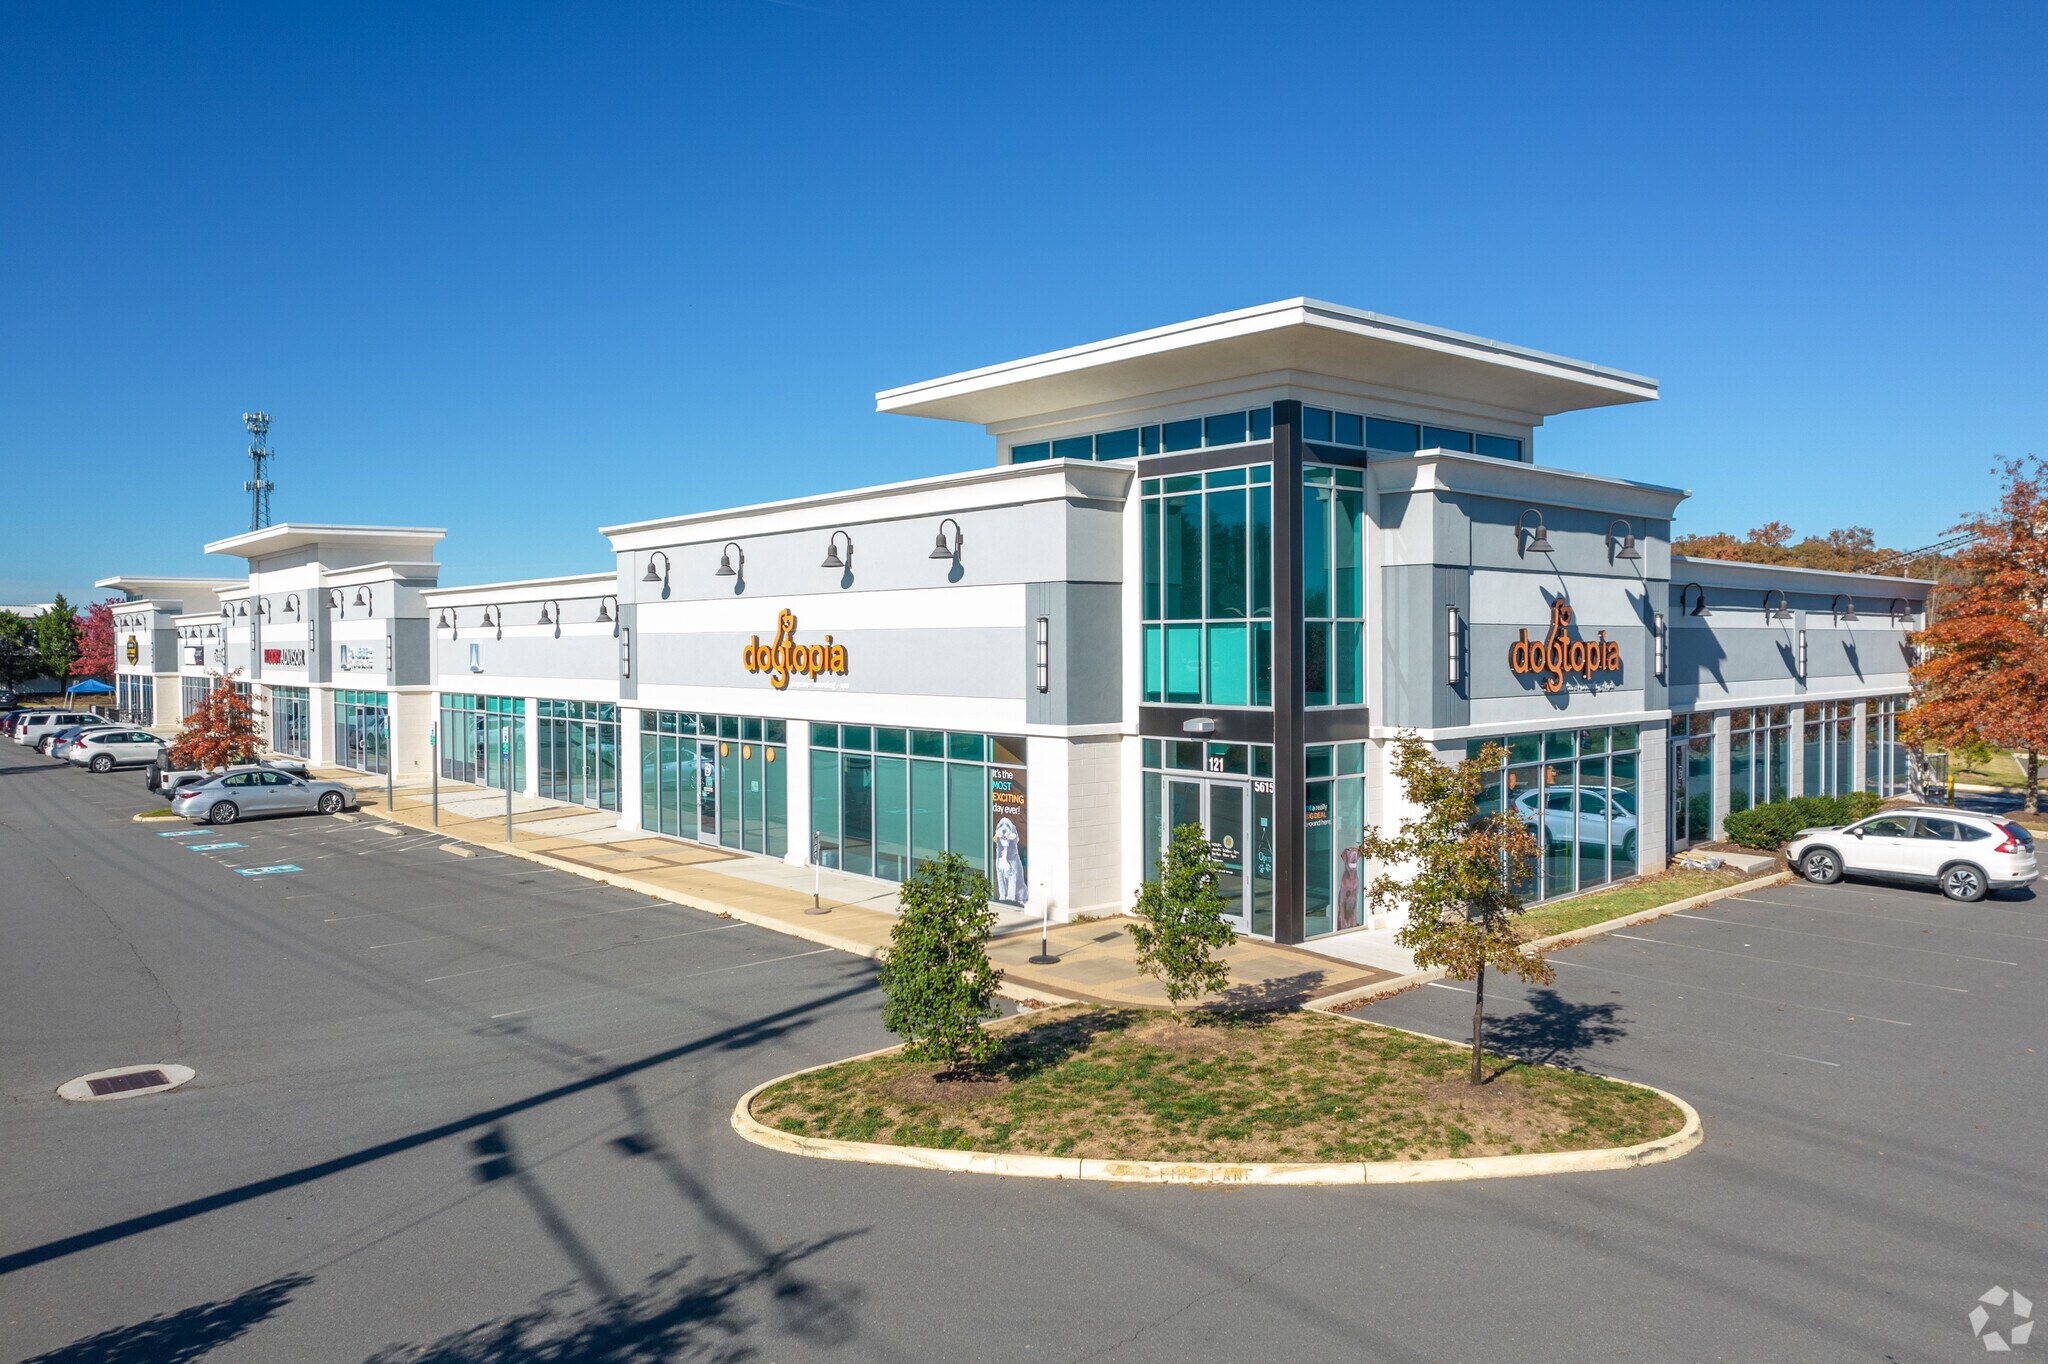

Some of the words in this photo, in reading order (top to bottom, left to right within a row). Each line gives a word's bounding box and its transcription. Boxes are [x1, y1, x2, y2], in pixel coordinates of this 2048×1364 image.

[743, 608, 848, 690] dogtopia
[1509, 597, 1620, 692] dogtopia
[1209, 757, 1224, 772] 121
[992, 768, 1002, 779] It's
[1002, 769, 1014, 779] the
[992, 780, 1012, 791] MOST
[1254, 781, 1274, 794] 5615
[992, 792, 1025, 804] EXCITING
[992, 802, 1004, 815] day
[1004, 805, 1021, 815] ever!
